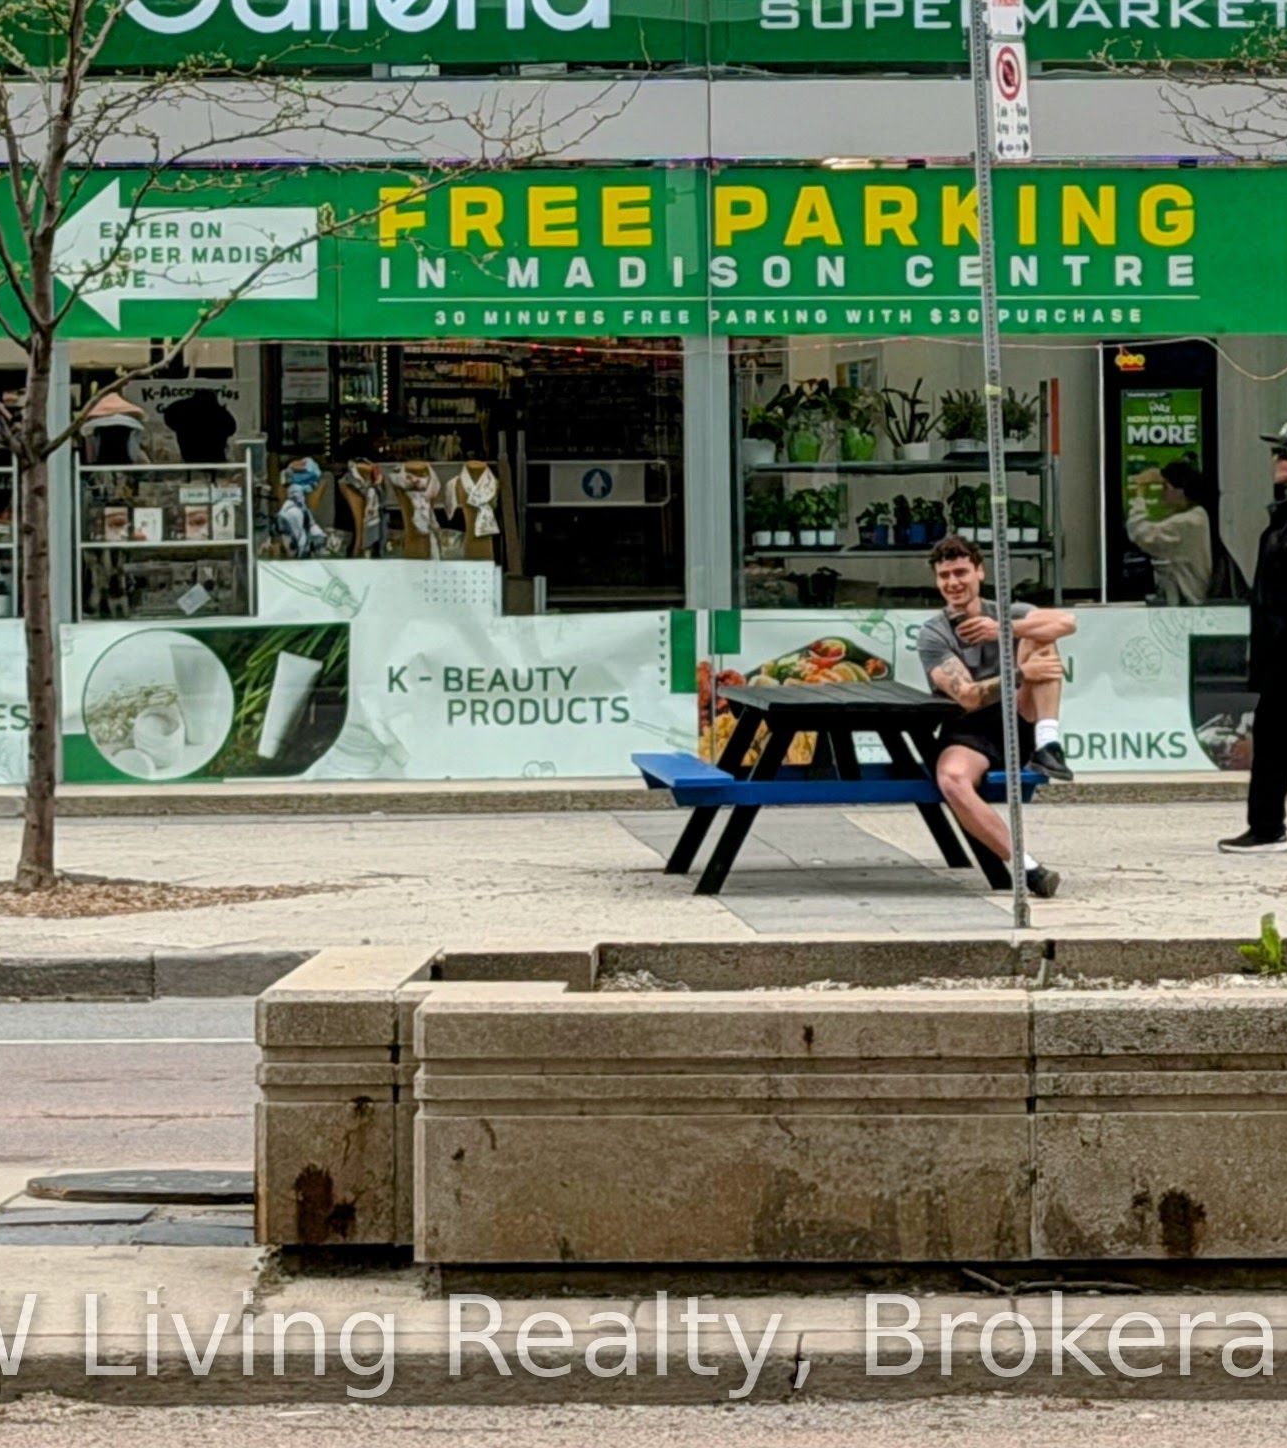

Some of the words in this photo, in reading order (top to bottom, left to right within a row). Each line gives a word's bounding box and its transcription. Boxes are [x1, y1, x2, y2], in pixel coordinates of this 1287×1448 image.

[99, 221, 180, 239] ENTER
[189, 221, 223, 238] ON
[378, 185, 653, 247] FREE
[714, 184, 1196, 246] PARKING
[191, 246, 304, 263] MADISON
[379, 256, 446, 289] IN
[506, 255, 846, 288] MADISON
[905, 254, 1196, 288] CENTRE
[434, 309, 467, 326] 30
[483, 309, 607, 325] MINUTES
[622, 308, 691, 325] FREE
[709, 308, 829, 324] PARKING
[845, 308, 913, 324] WITH
[929, 307, 981, 325] $30
[997, 308, 1143, 324] PURCHASE
[1126, 424, 1198, 445] MORE
[387, 665, 410, 694] K
[443, 664, 580, 693] BEAUTY
[447, 696, 631, 726] PRODUCTS
[1063, 730, 1188, 761] DRINKS
